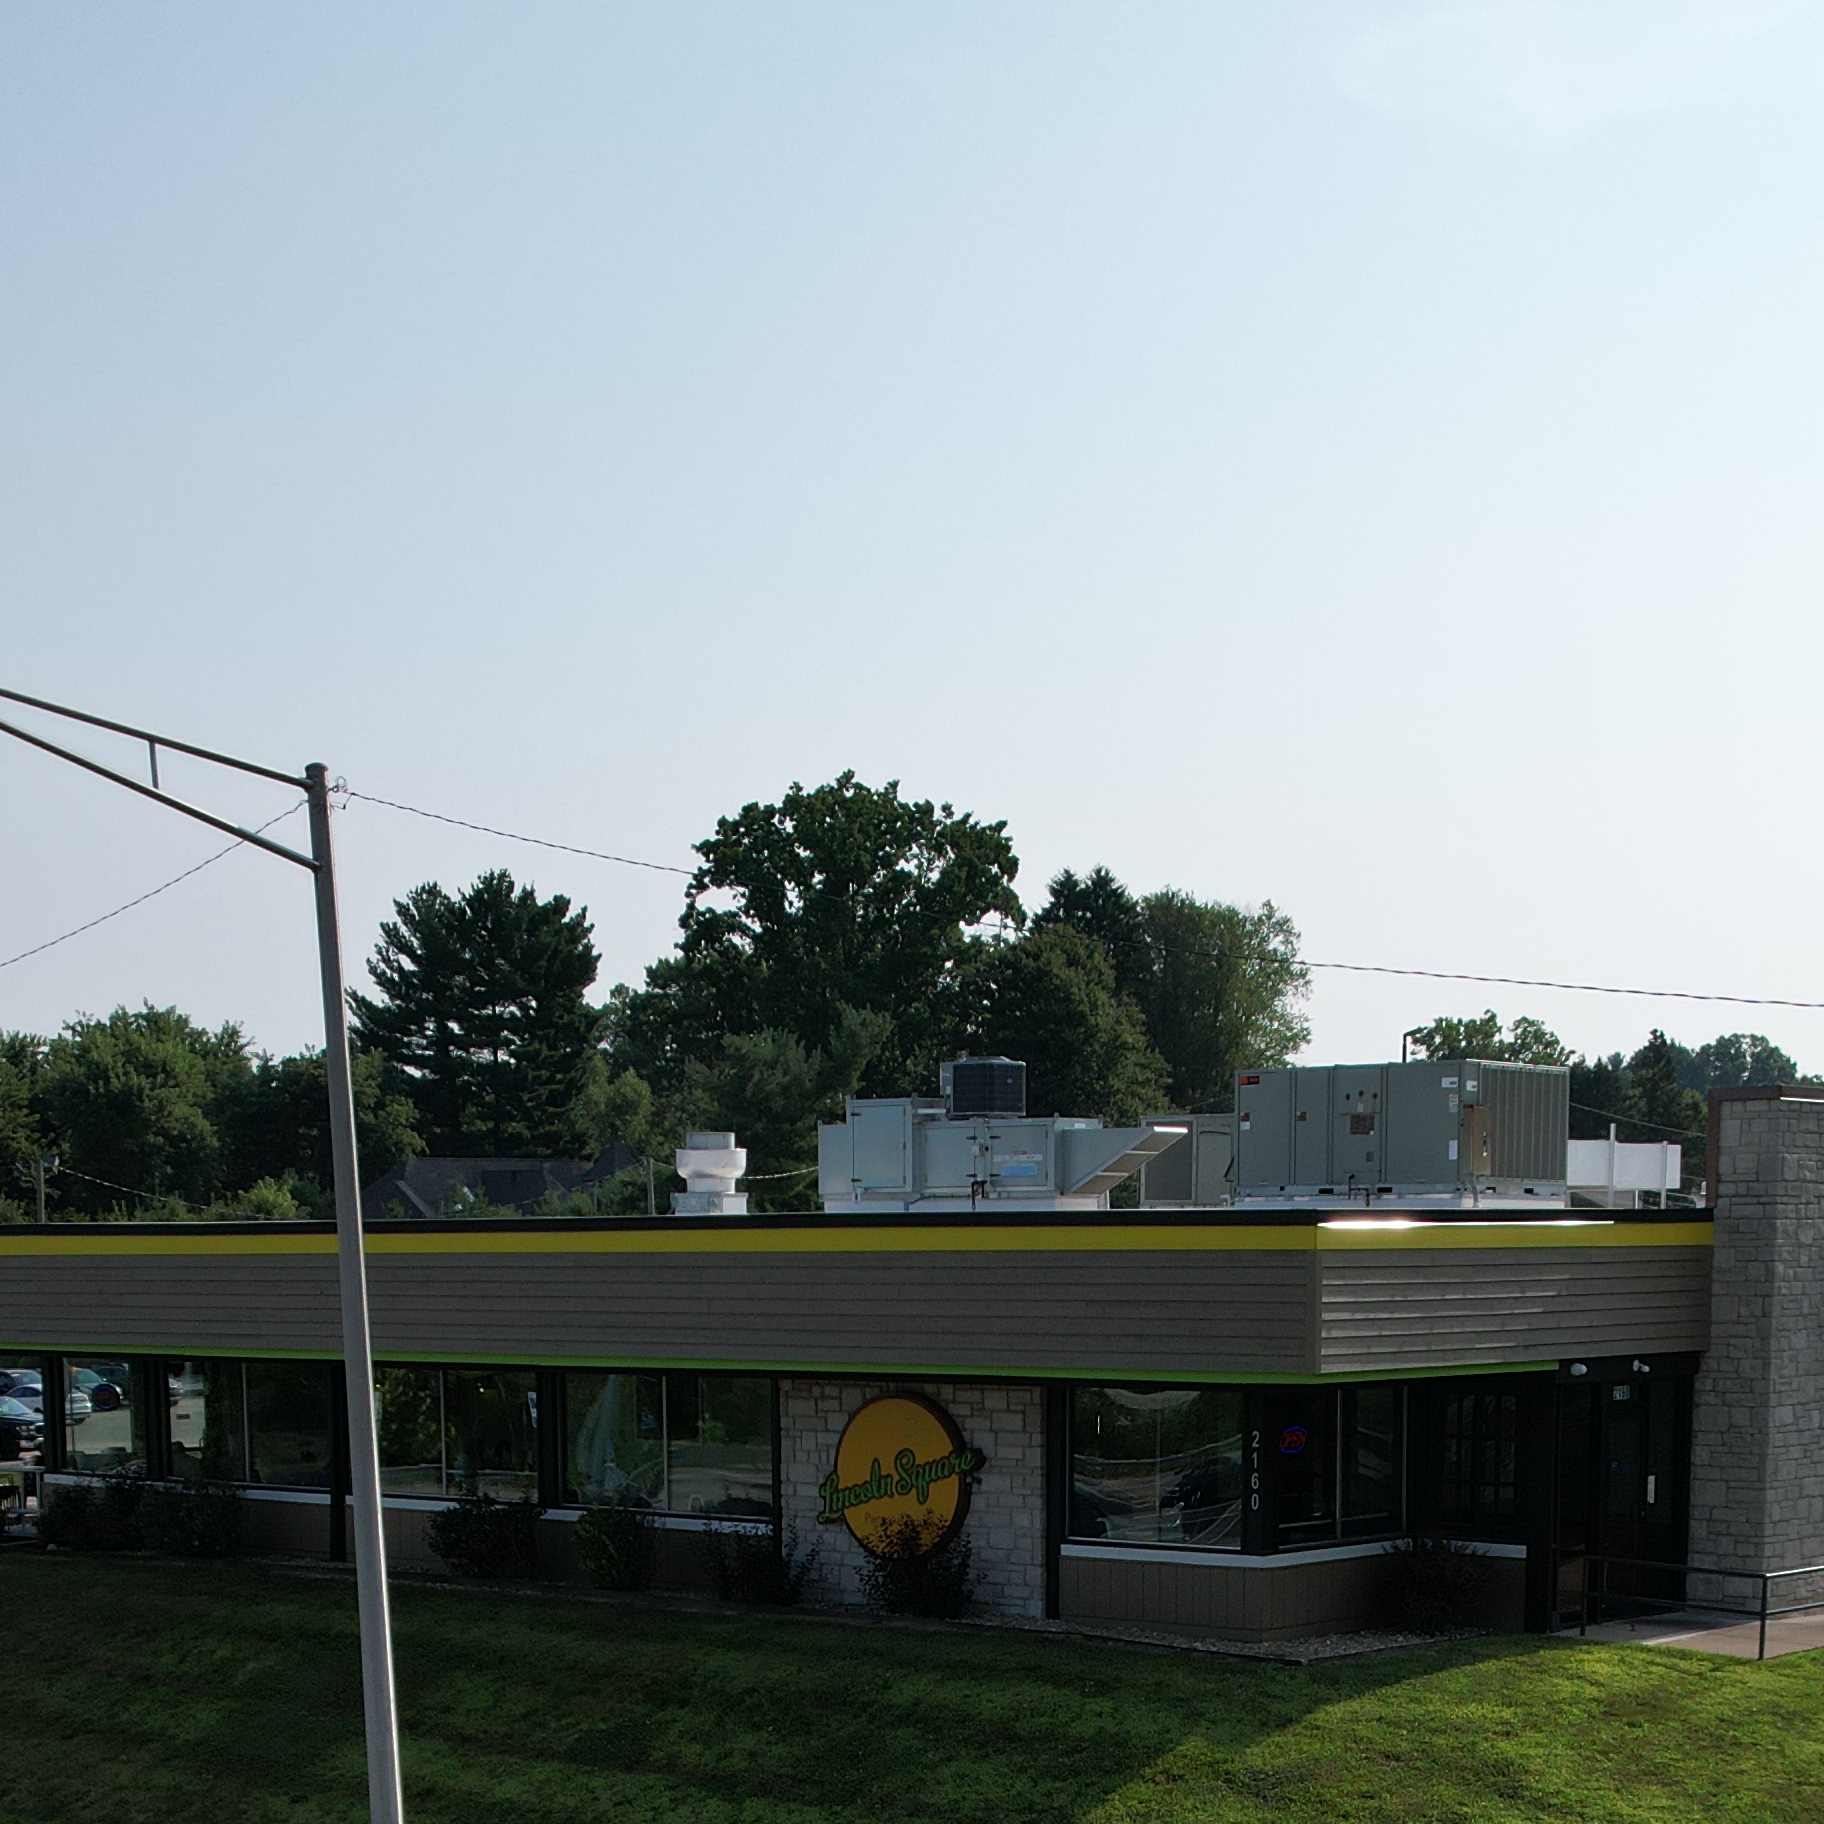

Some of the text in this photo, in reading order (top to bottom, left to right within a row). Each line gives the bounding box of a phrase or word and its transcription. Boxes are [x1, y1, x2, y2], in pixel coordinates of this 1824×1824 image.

[817, 1448, 974, 1525] Lincoln Square
[1251, 1430, 1260, 1511] 2160
